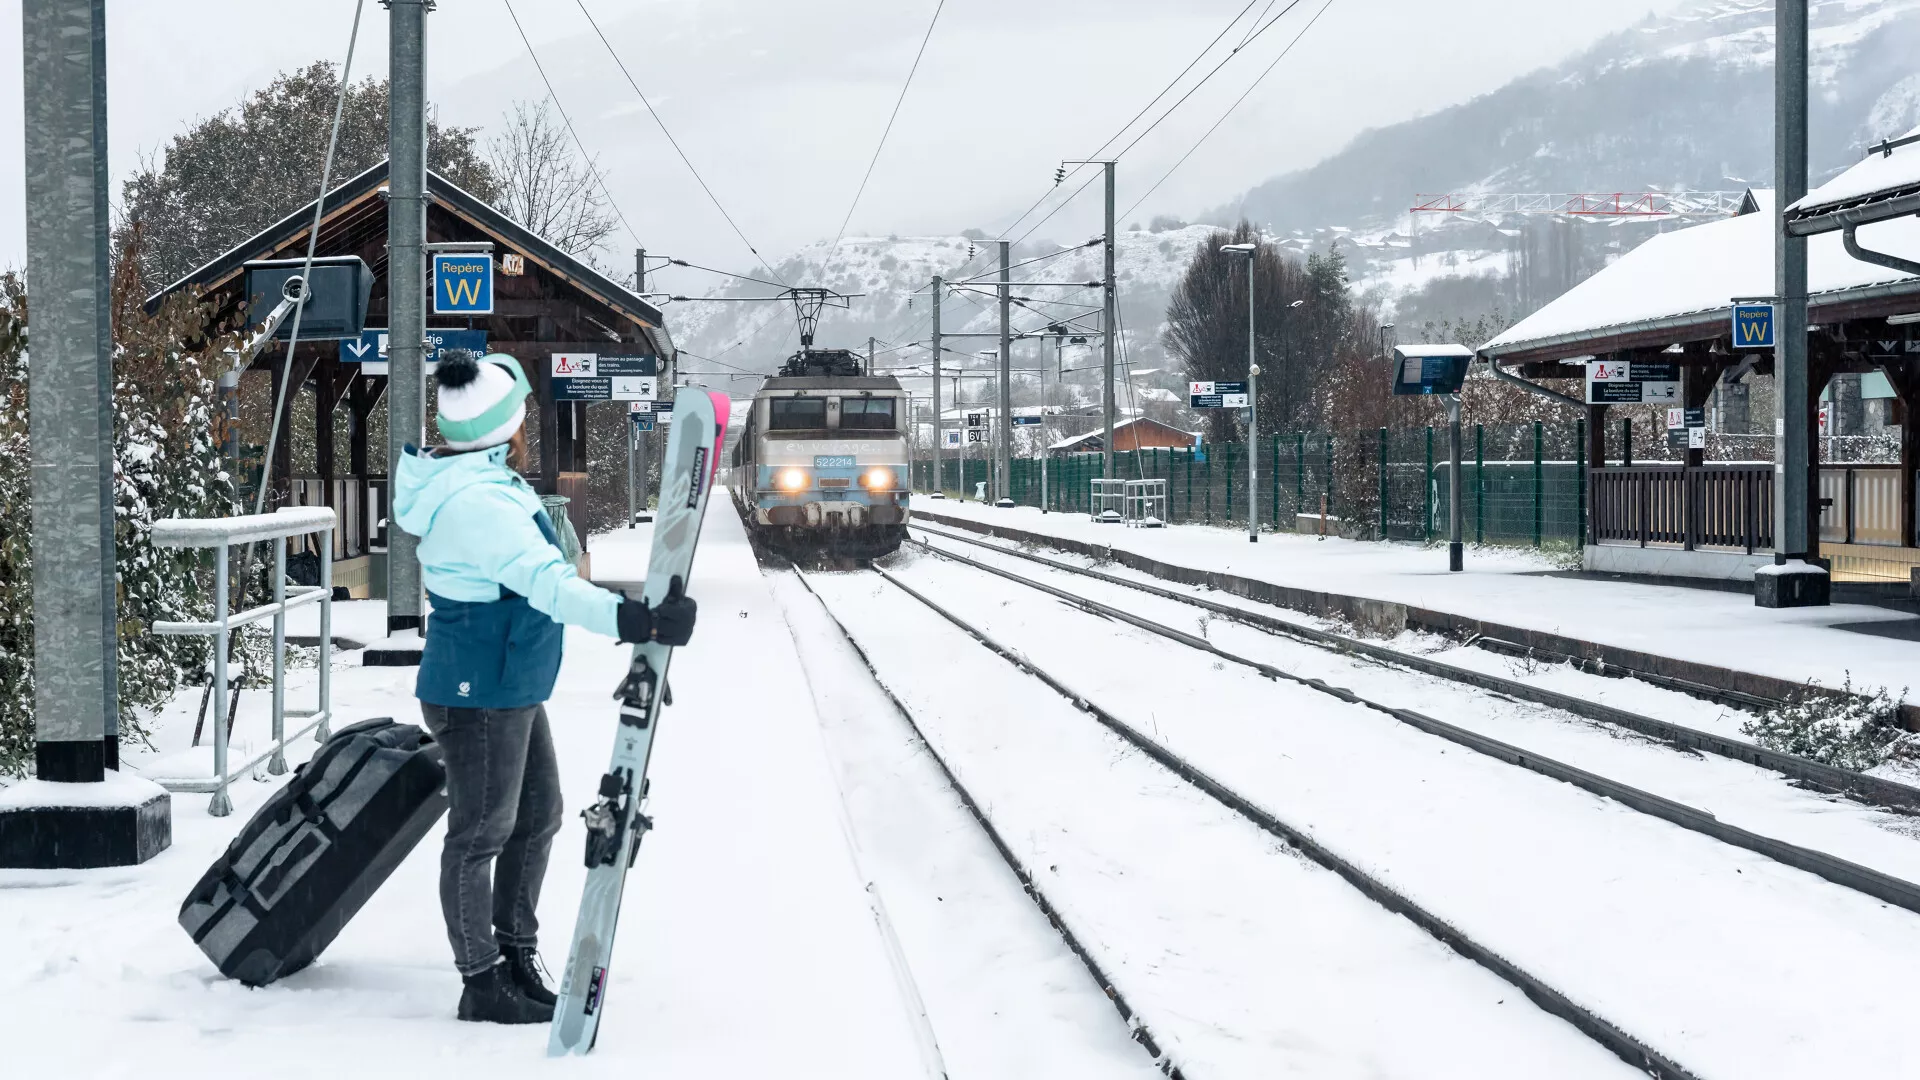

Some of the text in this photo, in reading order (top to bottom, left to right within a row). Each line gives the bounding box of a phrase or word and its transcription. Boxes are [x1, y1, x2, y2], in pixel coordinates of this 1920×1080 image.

[442, 262, 484, 275] Repère
[444, 278, 482, 306] W
[1740, 310, 1769, 319] Repère
[1741, 321, 1767, 342] W
[969, 431, 980, 440] 6V
[786, 443, 804, 453] en
[816, 458, 852, 467] 522214
[689, 448, 704, 505] SALOMON
